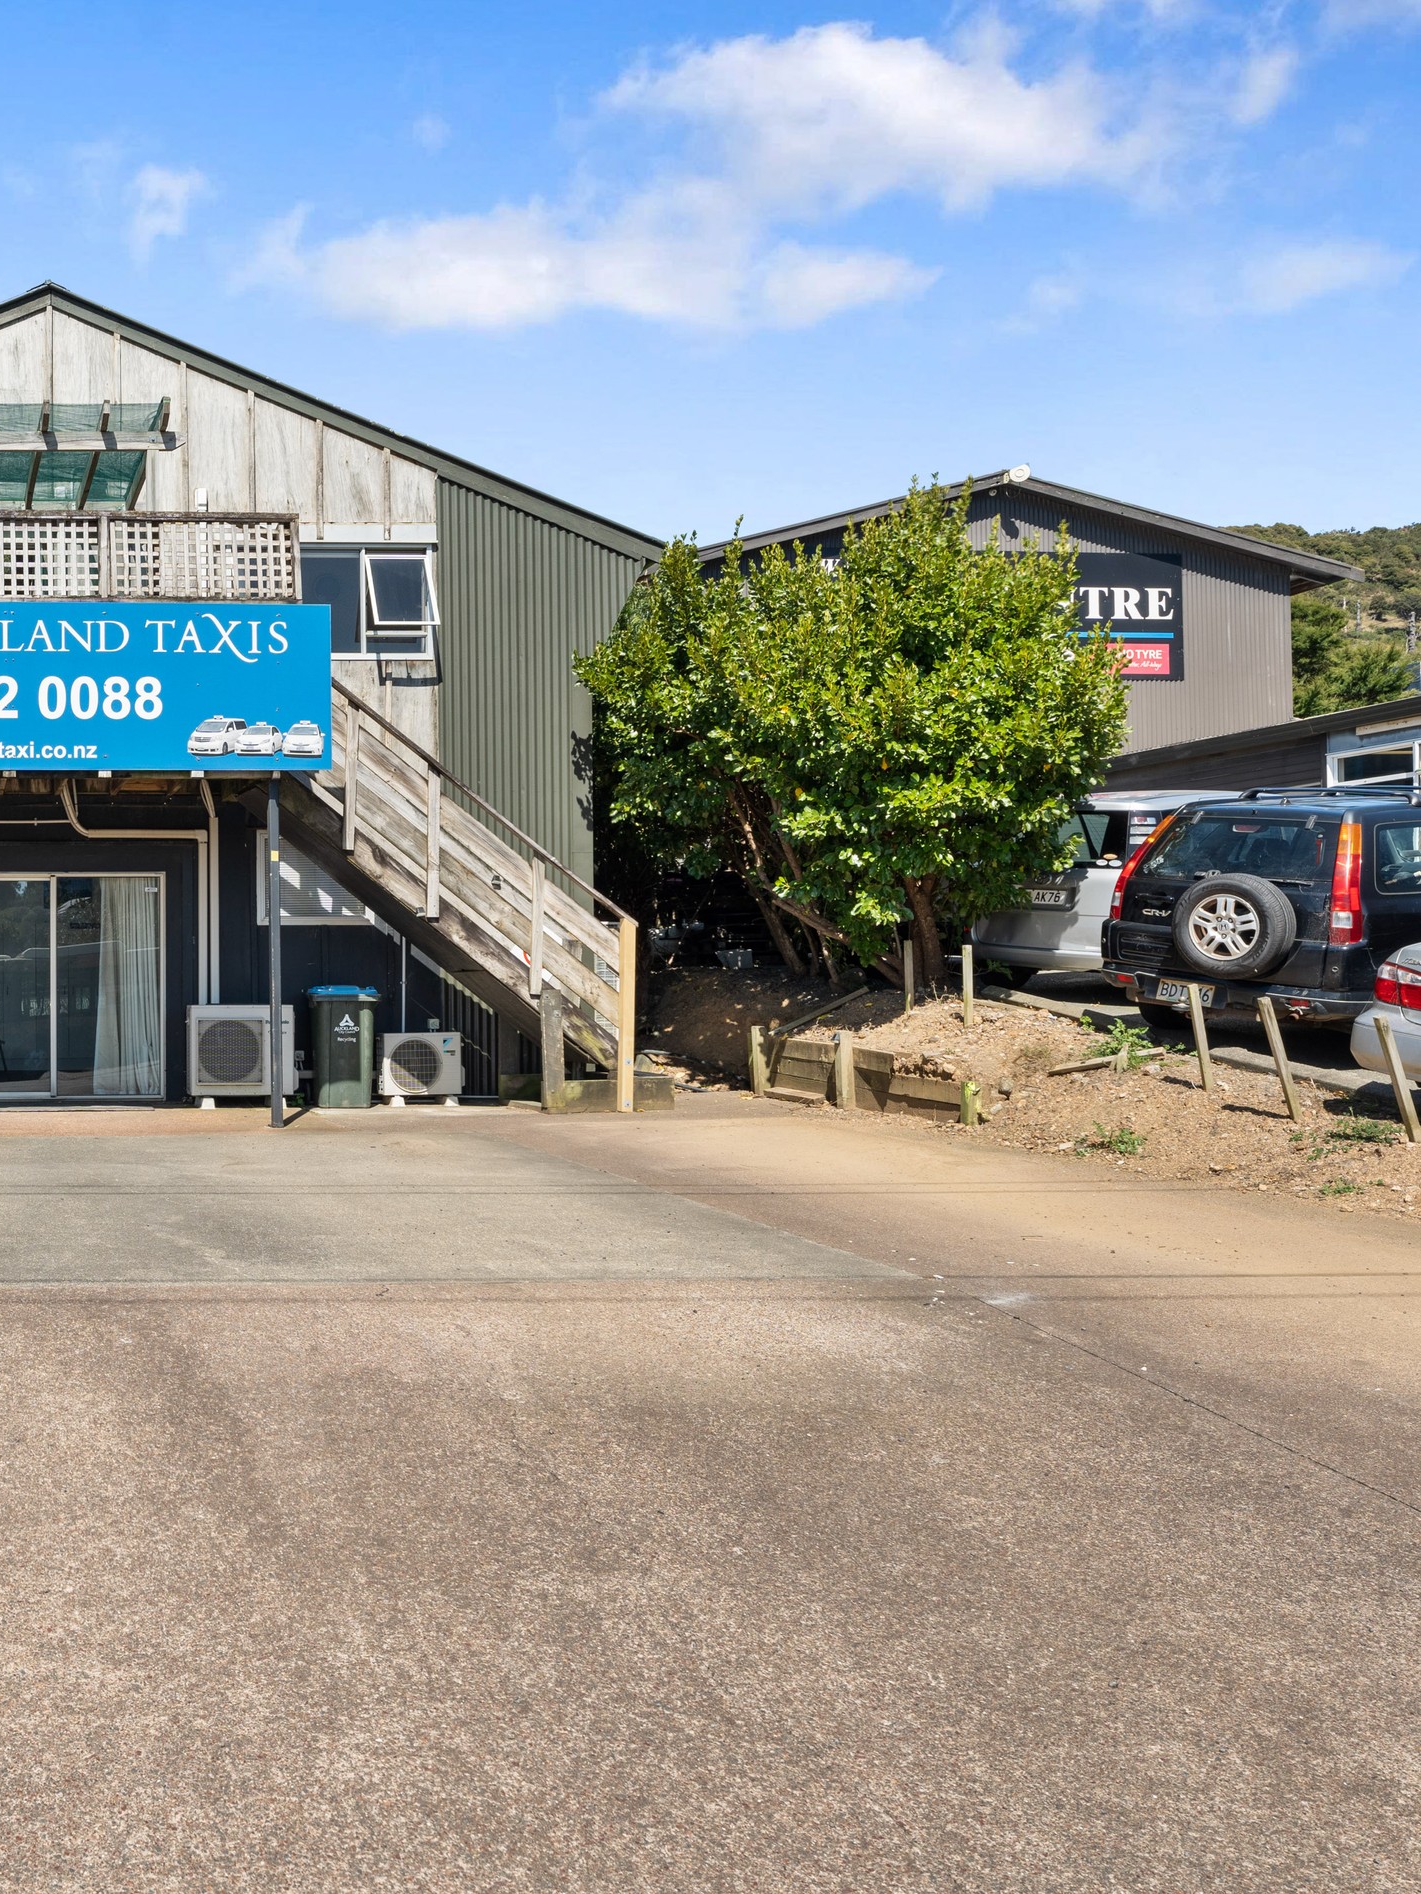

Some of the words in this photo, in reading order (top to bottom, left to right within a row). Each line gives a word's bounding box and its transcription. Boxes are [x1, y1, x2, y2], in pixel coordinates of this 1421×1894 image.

[145, 612, 290, 663] TAXIS
[1135, 649, 1163, 660] TYRE
[38, 675, 163, 720] 0088
[1142, 908, 1172, 918] CR-V
[1159, 982, 1210, 1003] BDT16
